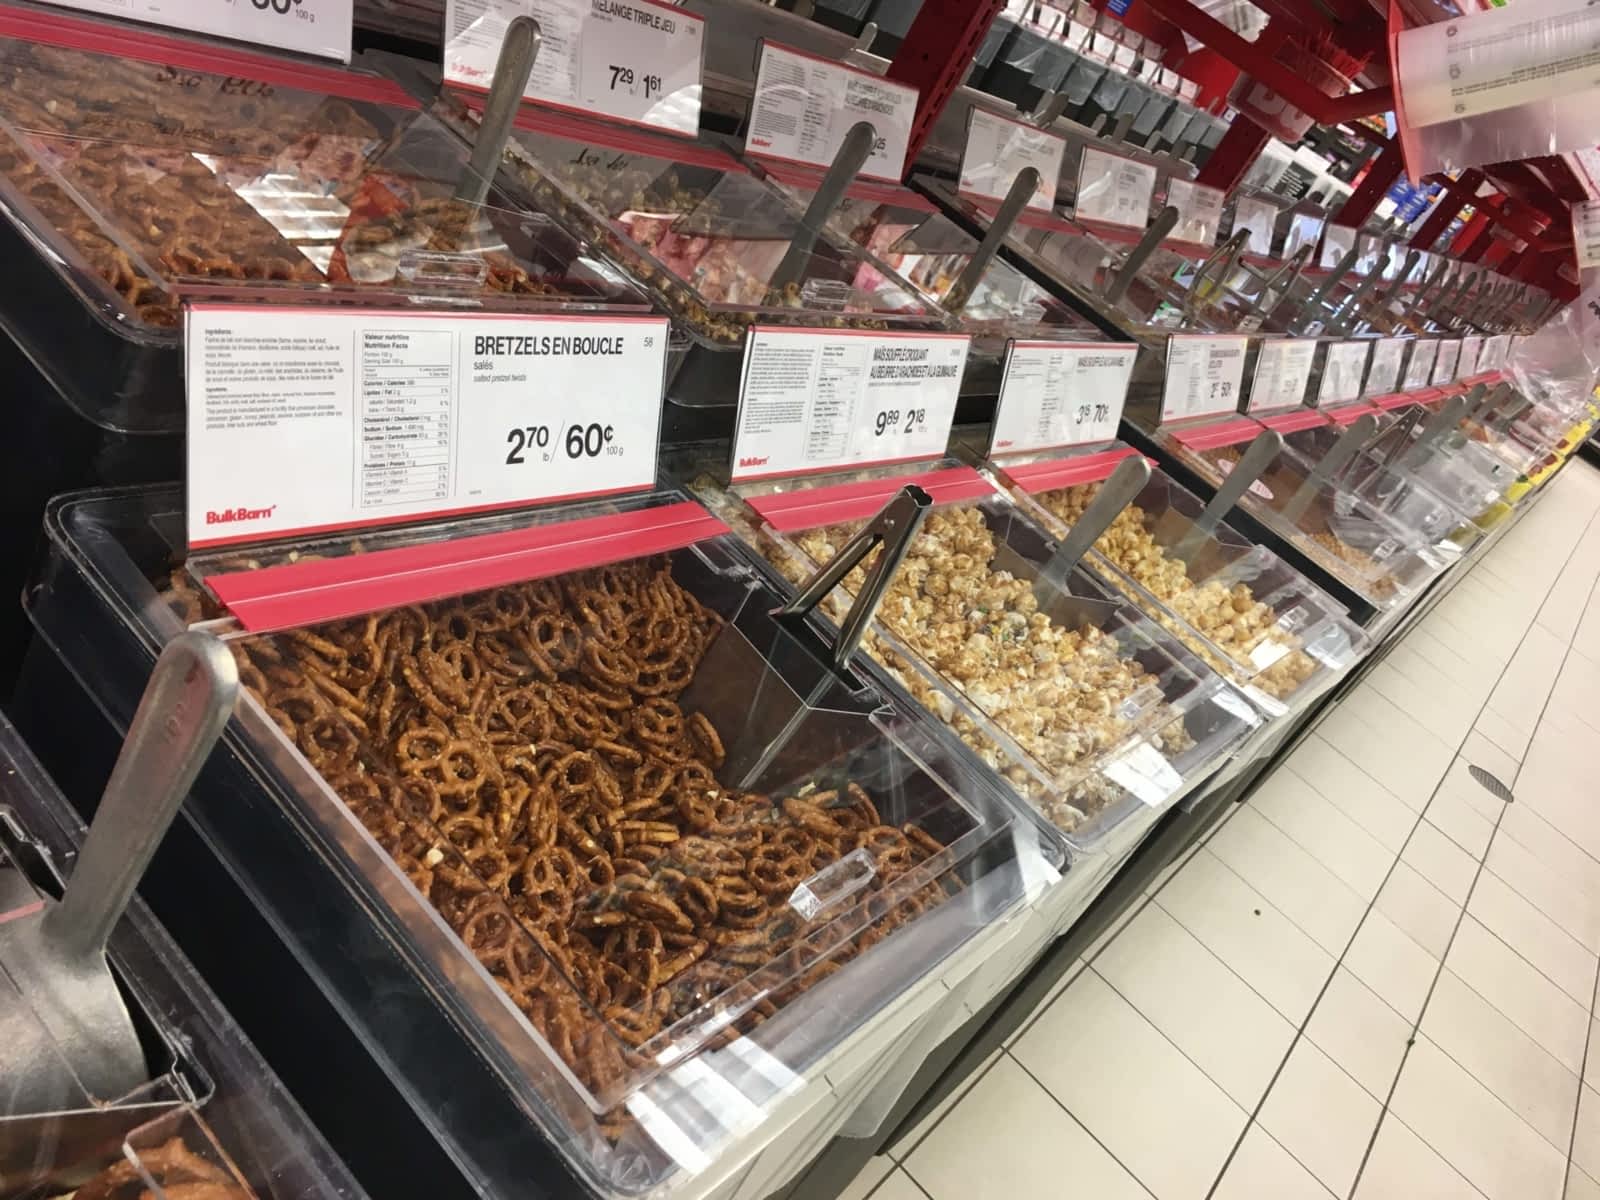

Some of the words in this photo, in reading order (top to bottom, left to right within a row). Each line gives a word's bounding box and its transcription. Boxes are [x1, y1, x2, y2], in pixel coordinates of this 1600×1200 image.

[295, 9, 308, 20] 100
[309, 14, 315, 23] g
[633, 9, 661, 30] TRIPLE
[661, 18, 676, 34] JEU
[474, 336, 551, 355] BRETZELS
[552, 337, 571, 355] EN
[572, 337, 624, 355] BOUCLE
[473, 360, 494, 371] salés
[565, 422, 614, 459] 60¢
[606, 447, 618, 456] 100
[619, 447, 624, 456] g
[206, 506, 274, 525] BulkBarn
